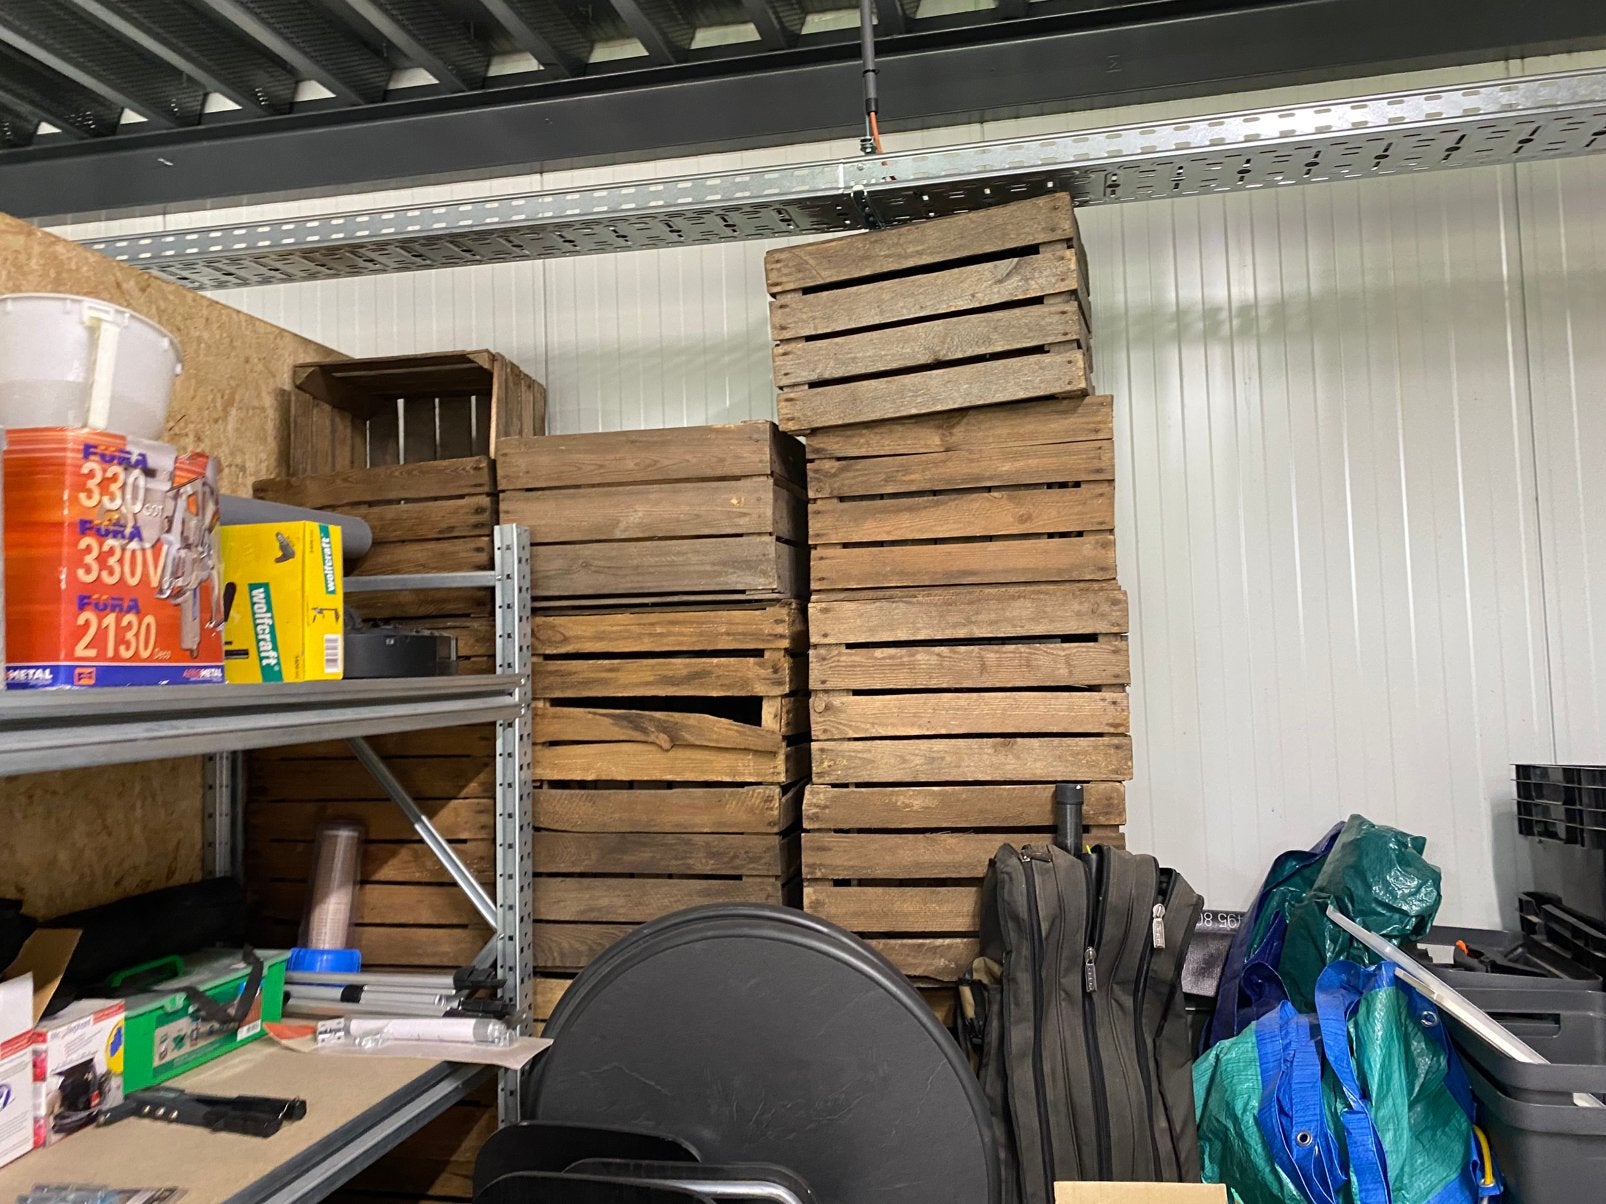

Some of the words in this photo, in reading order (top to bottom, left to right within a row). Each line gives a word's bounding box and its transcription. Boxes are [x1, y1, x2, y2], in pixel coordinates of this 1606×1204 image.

[78, 461, 146, 514] 330
[76, 536, 168, 588] 330V
[321, 537, 336, 592] wolfcraft
[74, 611, 157, 659] 2130
[251, 587, 279, 666] wolfcraft
[6, 668, 53, 680] METAL
